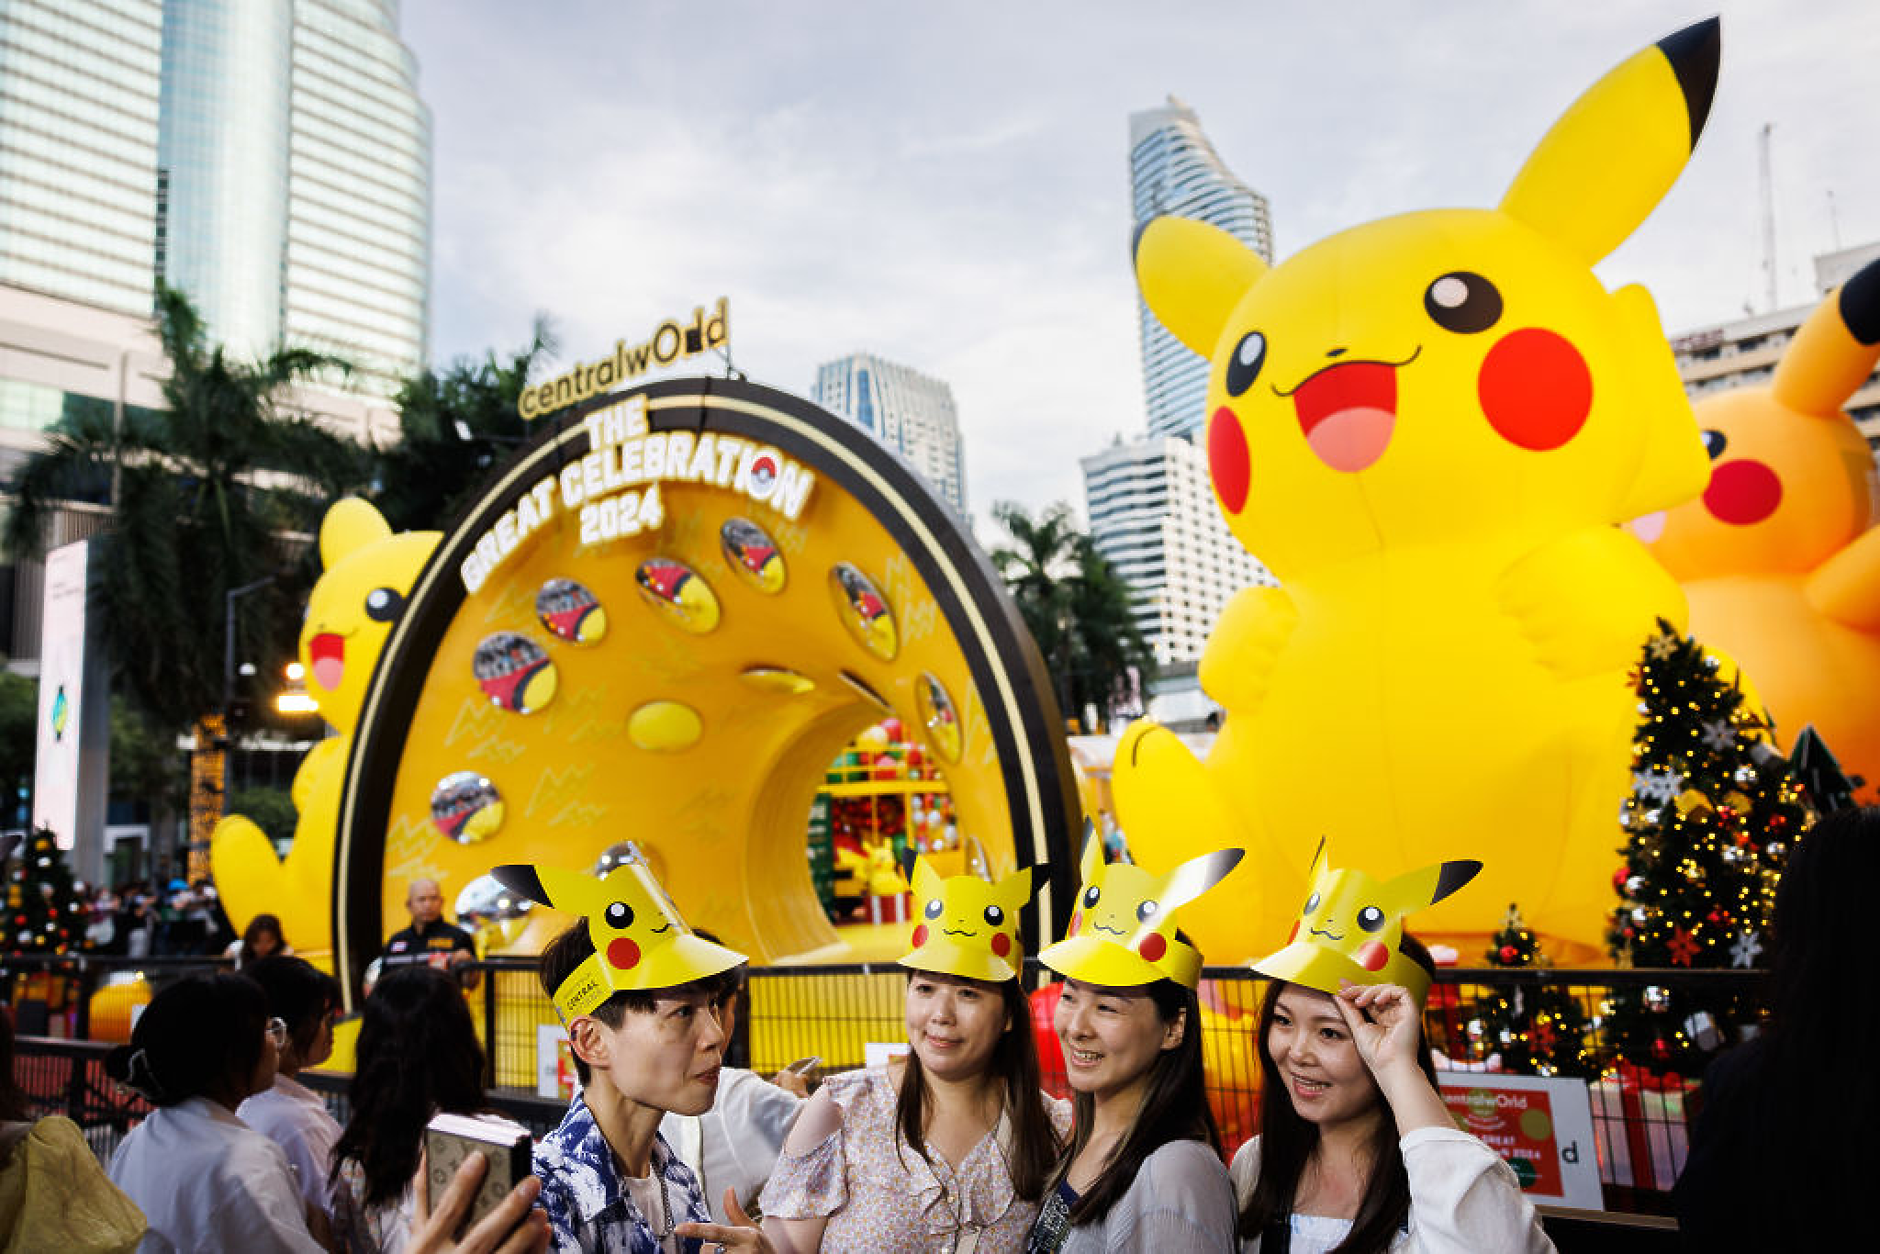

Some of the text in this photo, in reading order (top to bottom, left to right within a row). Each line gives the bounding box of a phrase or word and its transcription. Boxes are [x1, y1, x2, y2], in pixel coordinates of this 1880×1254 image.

[585, 393, 647, 449] THE
[461, 431, 815, 594] GREAT CELEBRATION
[580, 483, 664, 546] 2024
